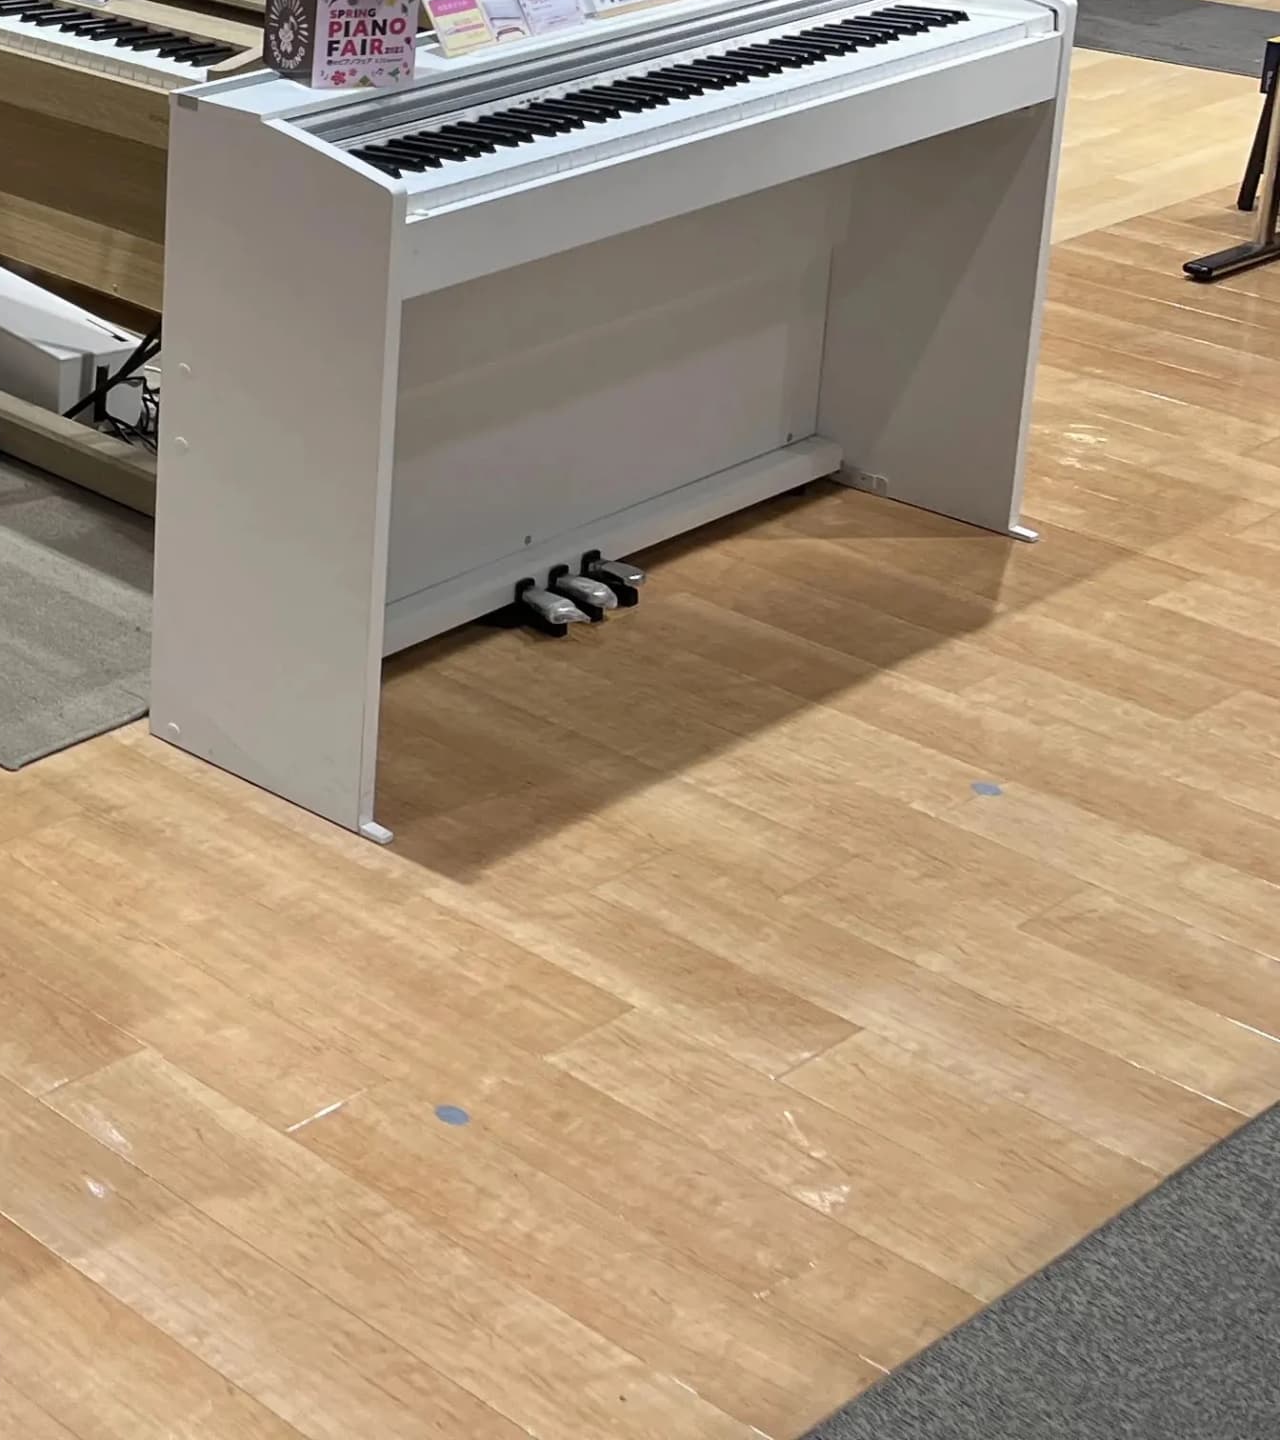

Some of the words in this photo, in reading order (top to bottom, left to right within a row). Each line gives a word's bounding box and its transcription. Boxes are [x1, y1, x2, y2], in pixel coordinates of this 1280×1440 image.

[330, 8, 376, 19] SPRING
[328, 17, 407, 38] PIANO
[327, 38, 385, 57] FAIR
